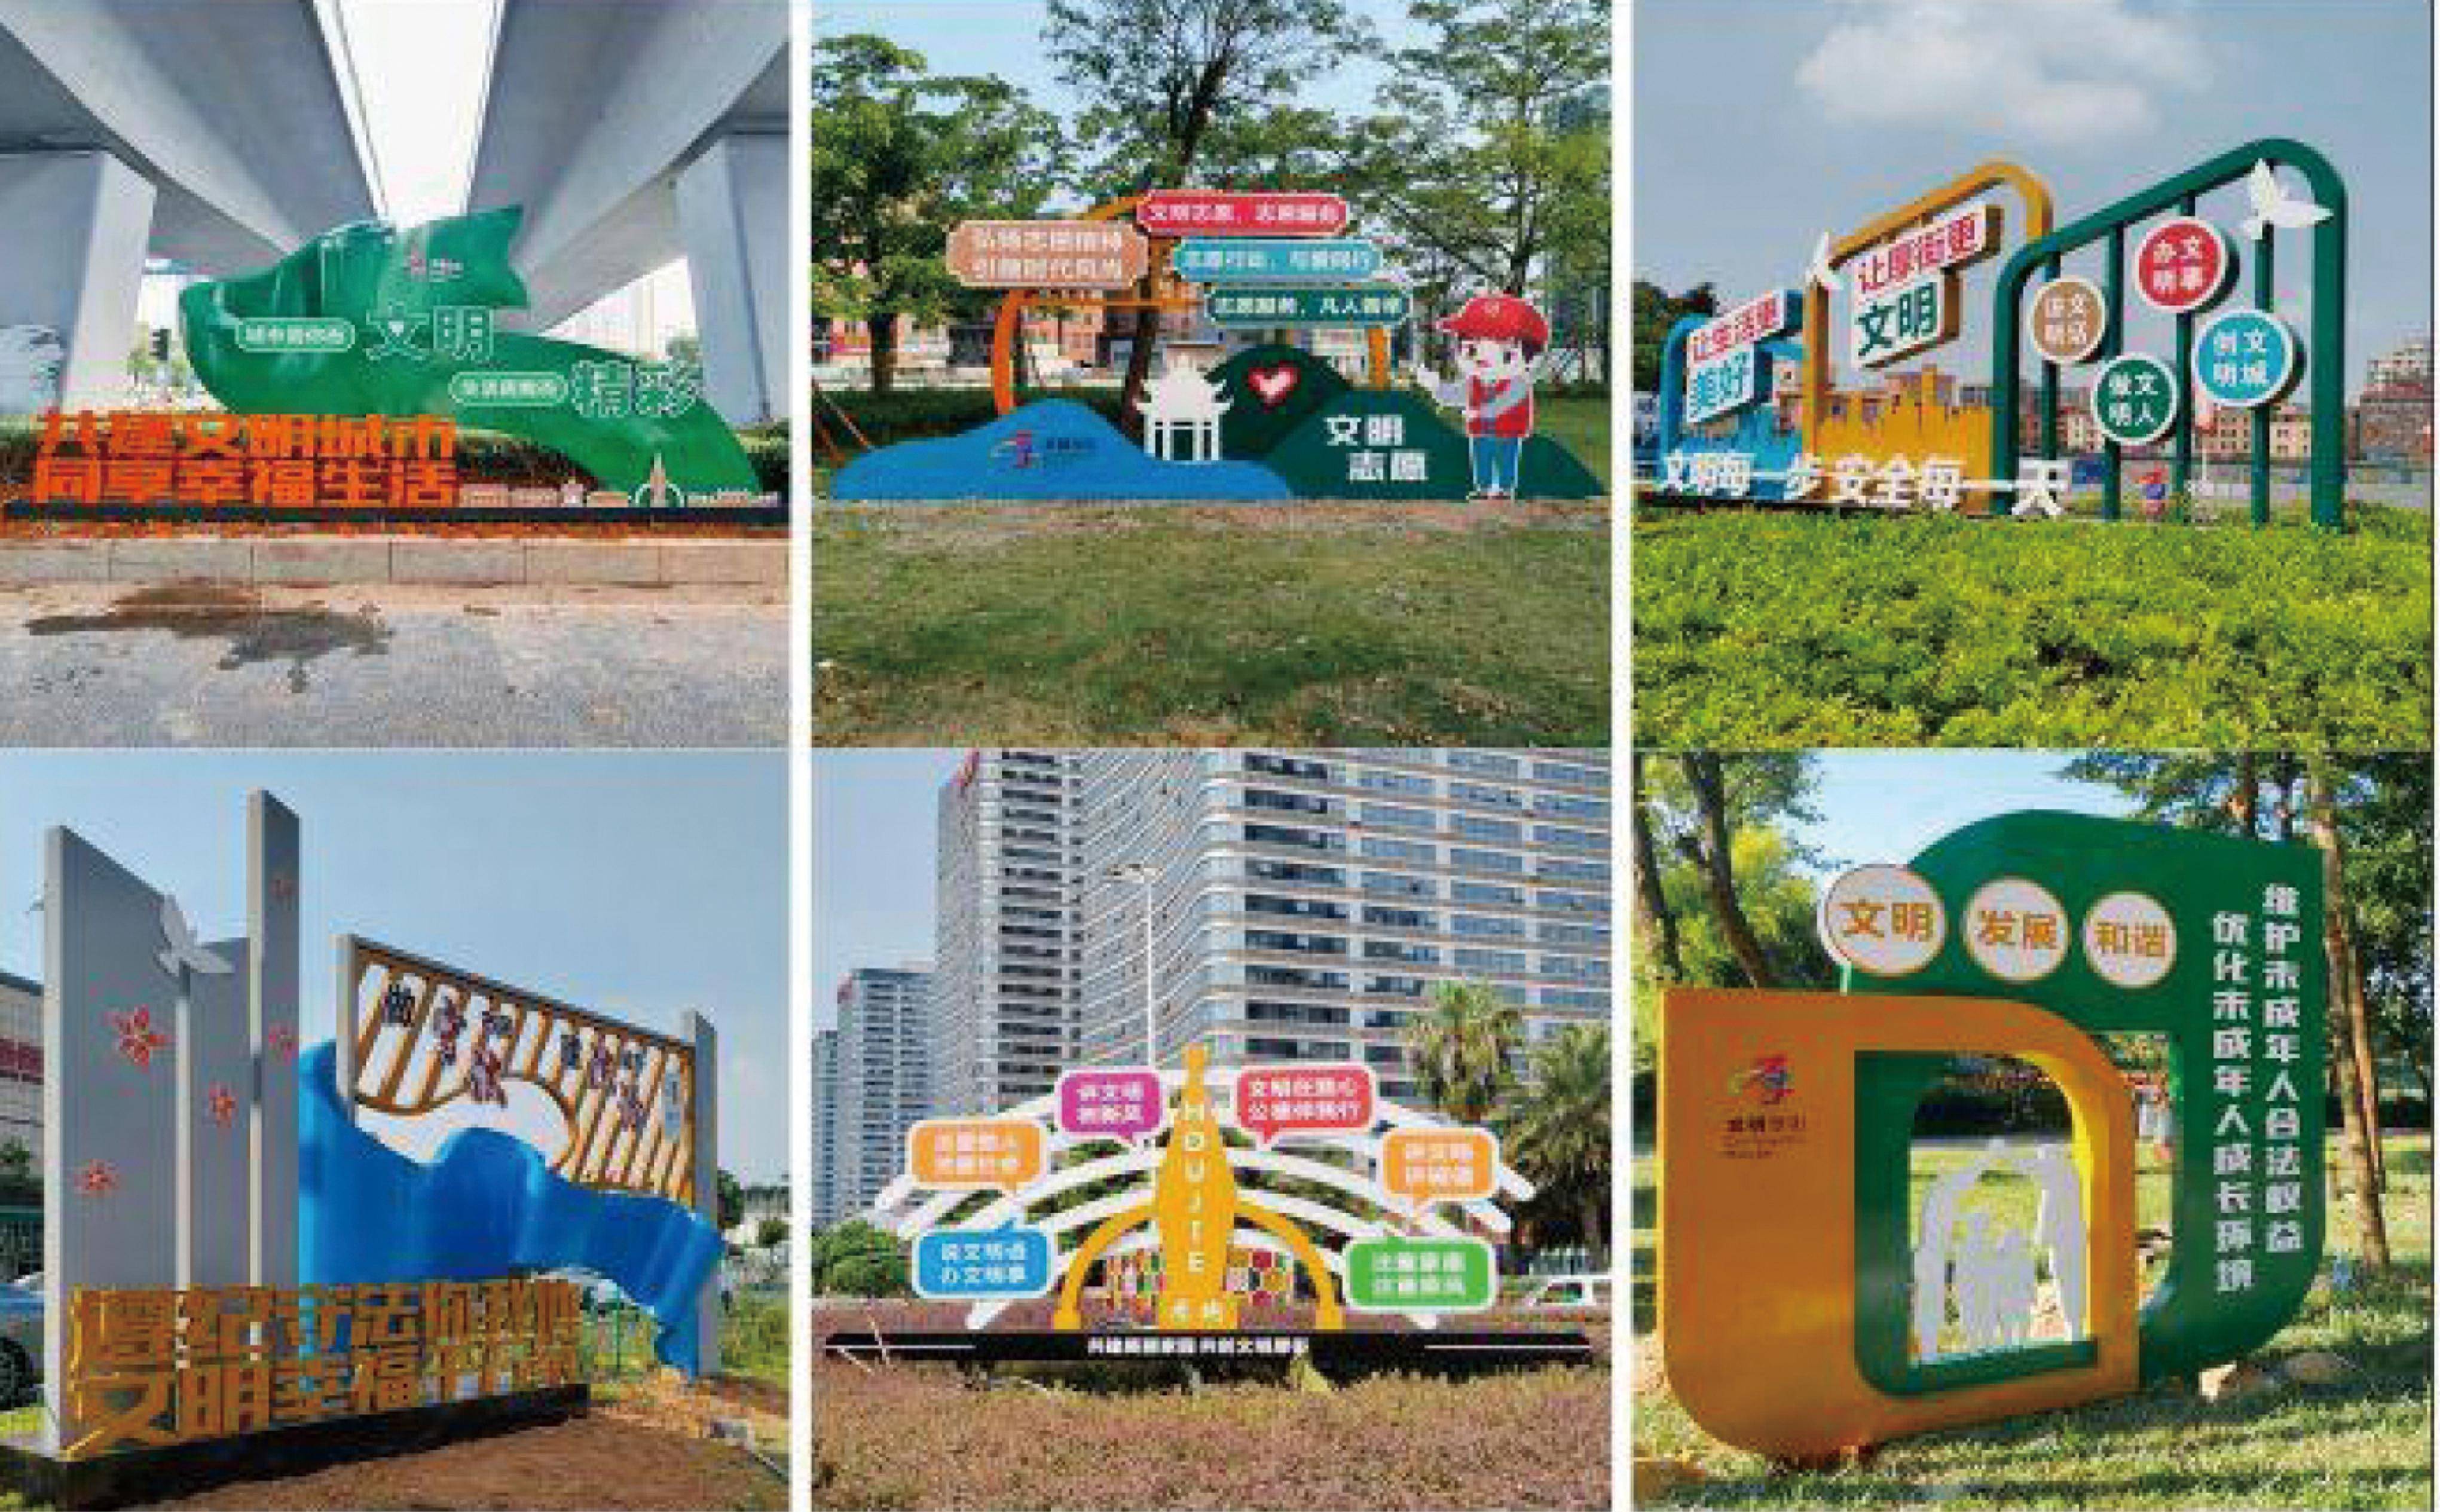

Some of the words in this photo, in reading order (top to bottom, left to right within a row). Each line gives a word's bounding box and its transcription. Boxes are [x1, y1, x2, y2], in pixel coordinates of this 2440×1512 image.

[1858, 213, 1975, 293] 让厚街更
[365, 300, 495, 360] 文明
[1689, 297, 1778, 362] 让生活更
[1857, 281, 1937, 357] 文明
[569, 359, 698, 418] 精彩
[1689, 351, 1751, 418] 美好
[1323, 414, 1403, 446] 文明
[1346, 451, 1430, 482] 志愿
[1839, 898, 1935, 942] 文明
[1978, 909, 2058, 951] 发展
[2093, 922, 2166, 957] 和谐
[2262, 883, 2303, 1253] 维护未成年人合法权益
[2210, 910, 2253, 1294] 优化未成年人成长环境
